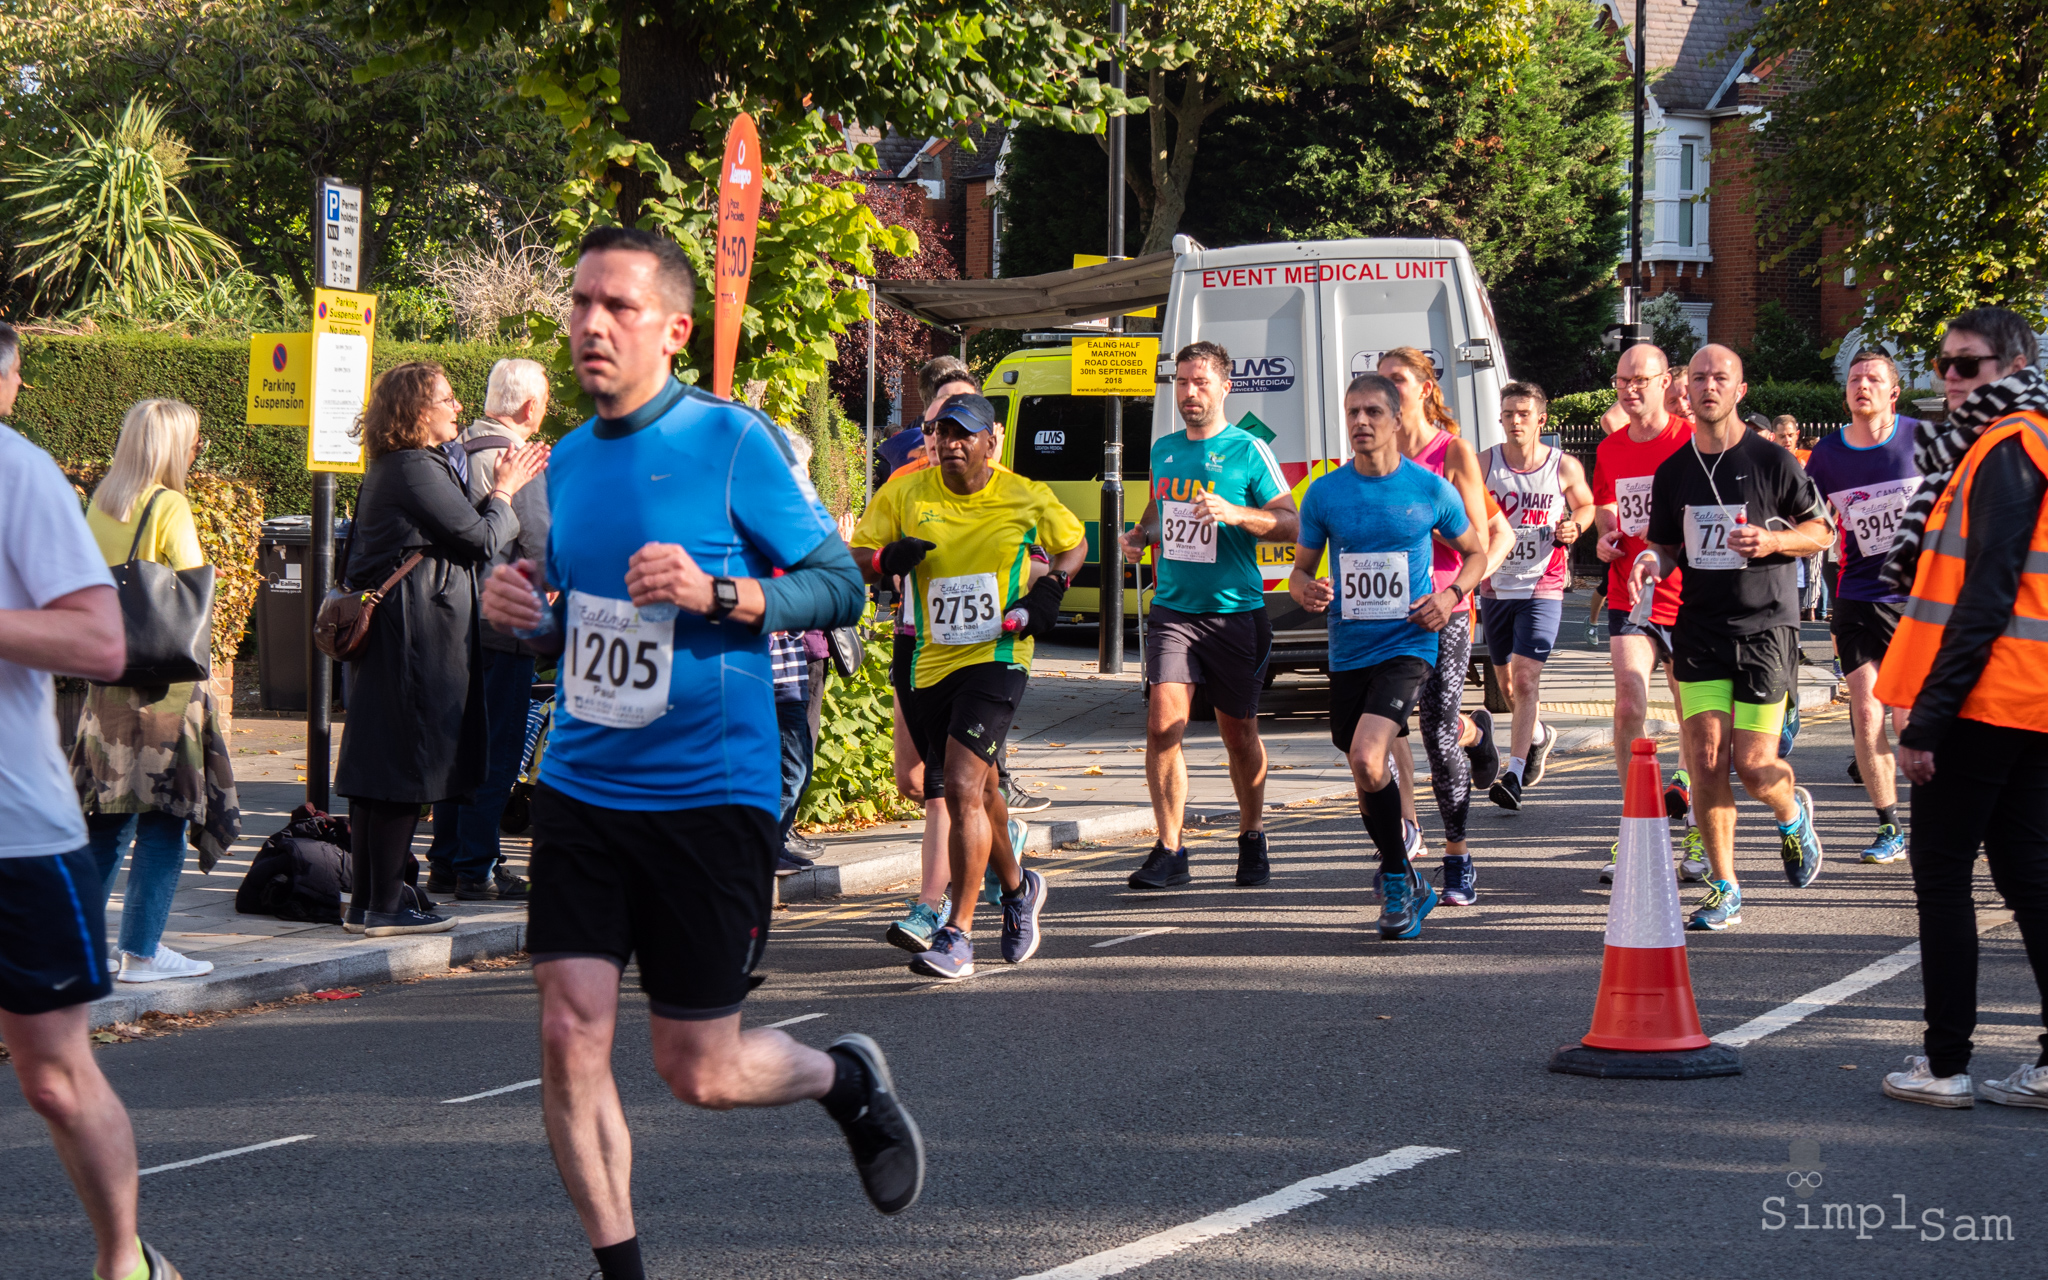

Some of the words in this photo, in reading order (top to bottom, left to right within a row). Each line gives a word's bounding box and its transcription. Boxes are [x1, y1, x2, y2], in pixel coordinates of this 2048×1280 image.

[329, 192, 339, 218] P
[342, 199, 359, 212] Permit
[341, 211, 359, 224] holders
[328, 225, 339, 239] NN
[344, 225, 355, 237] only
[332, 247, 342, 257] Mon
[721, 235, 747, 278] 1:50
[1202, 267, 1277, 289] EVENT
[1285, 262, 1388, 284] MEDICAL
[1396, 260, 1448, 279] UNIT
[336, 296, 358, 310] Parking
[329, 308, 363, 321] Suspension
[329, 325, 338, 334] No
[1087, 341, 1117, 349] EALING
[1119, 341, 1141, 349] HALF
[1230, 357, 1287, 377] LMS
[262, 378, 296, 395] Parking
[1076, 387, 1153, 395] www.ealinghalfmarathon.com
[254, 395, 304, 412] Suspension
[1043, 431, 1063, 444] LMS
[1156, 477, 1216, 501] RUN
[1520, 492, 1554, 509] MAKE
[1520, 508, 1549, 525] 2NDS
[1692, 511, 1725, 522] Ealing
[1164, 518, 1212, 545] 3270
[1699, 523, 1726, 550] 72
[1175, 543, 1197, 551] Warren
[1262, 546, 1295, 562] LMS
[1352, 559, 1387, 570] Ealing
[940, 582, 977, 594] Ealing
[1345, 572, 1403, 599] 5006
[932, 593, 995, 624] 2753
[578, 604, 631, 633] Ealing
[950, 623, 979, 631] Michael
[571, 627, 658, 690] 1205
[593, 686, 616, 699] Paul
